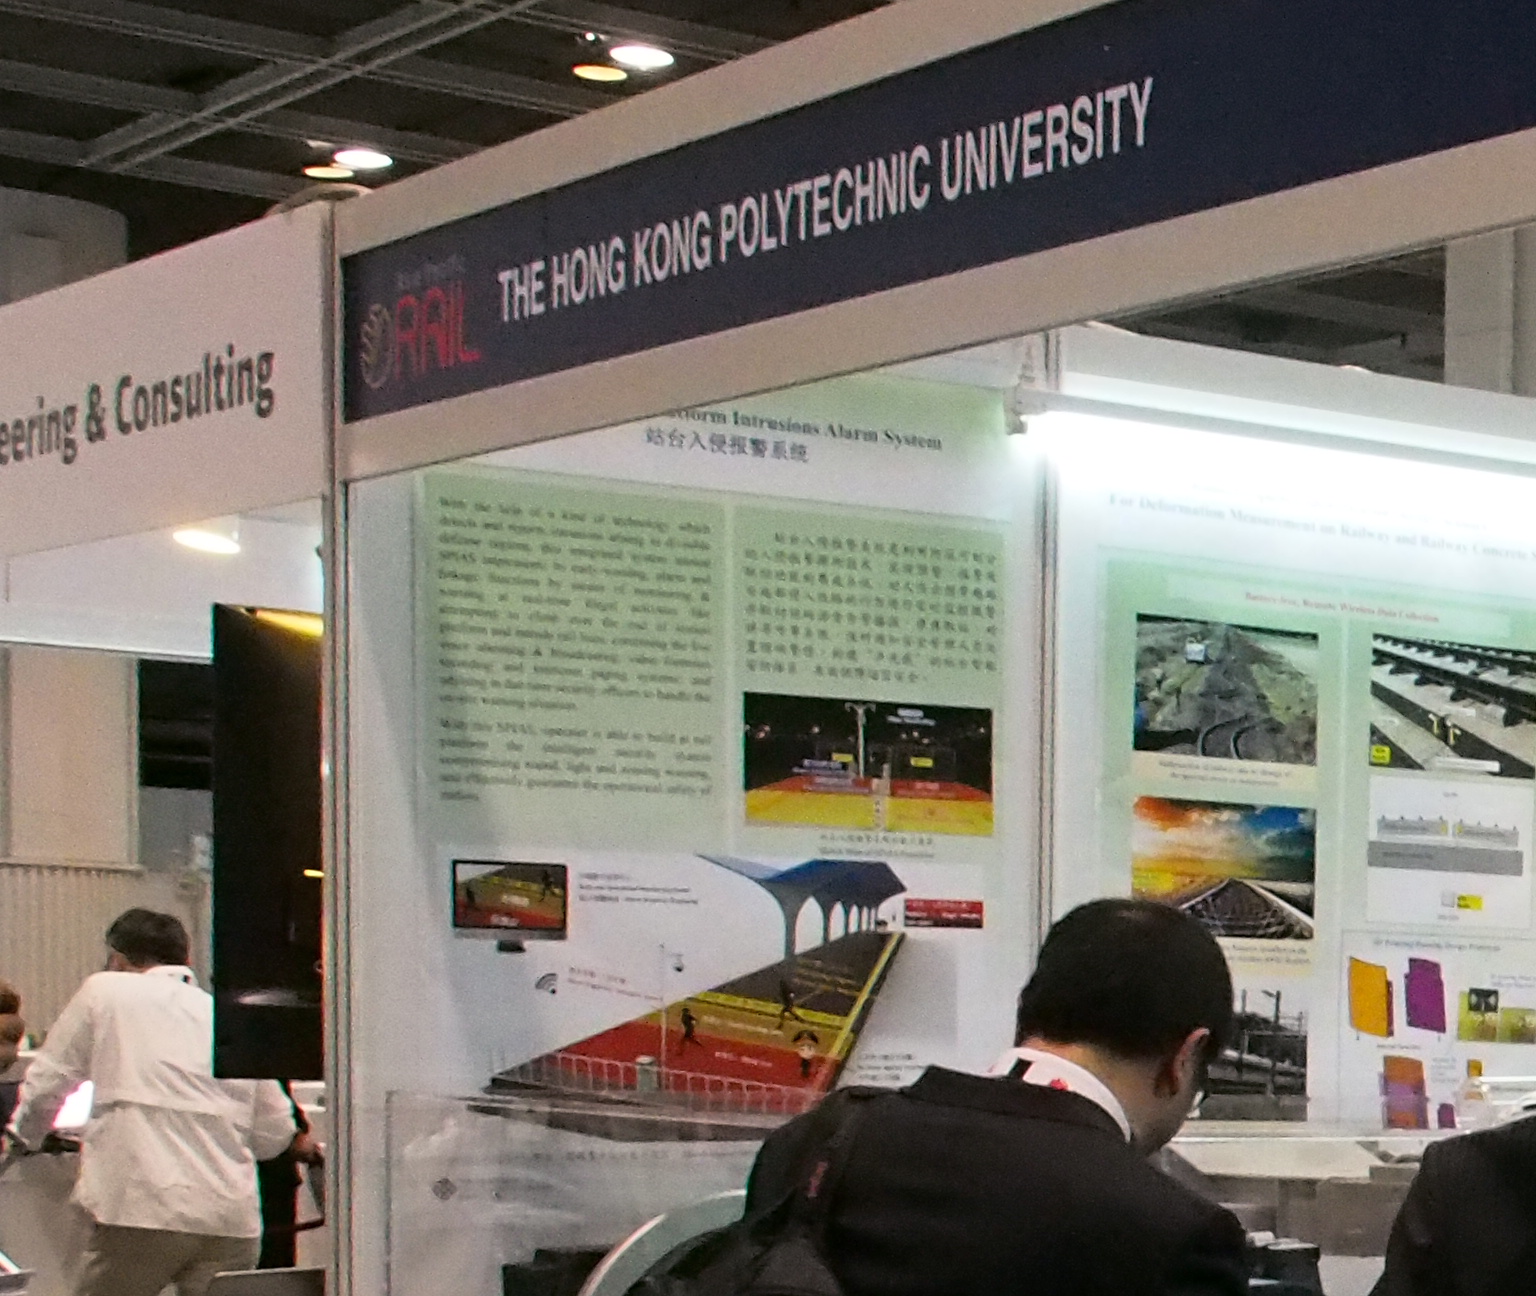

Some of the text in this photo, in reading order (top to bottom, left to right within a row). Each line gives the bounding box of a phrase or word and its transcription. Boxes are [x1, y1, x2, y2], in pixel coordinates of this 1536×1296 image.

[499, 76, 1154, 322] THE HONG KONG POLYTECHNIC UNIVERSITY
[393, 280, 482, 379] RAIL
[86, 383, 106, 443] &
[115, 342, 275, 435] Consulting
[732, 410, 820, 436] Intrusions
[825, 422, 879, 443] Alarm
[882, 429, 943, 451] System
